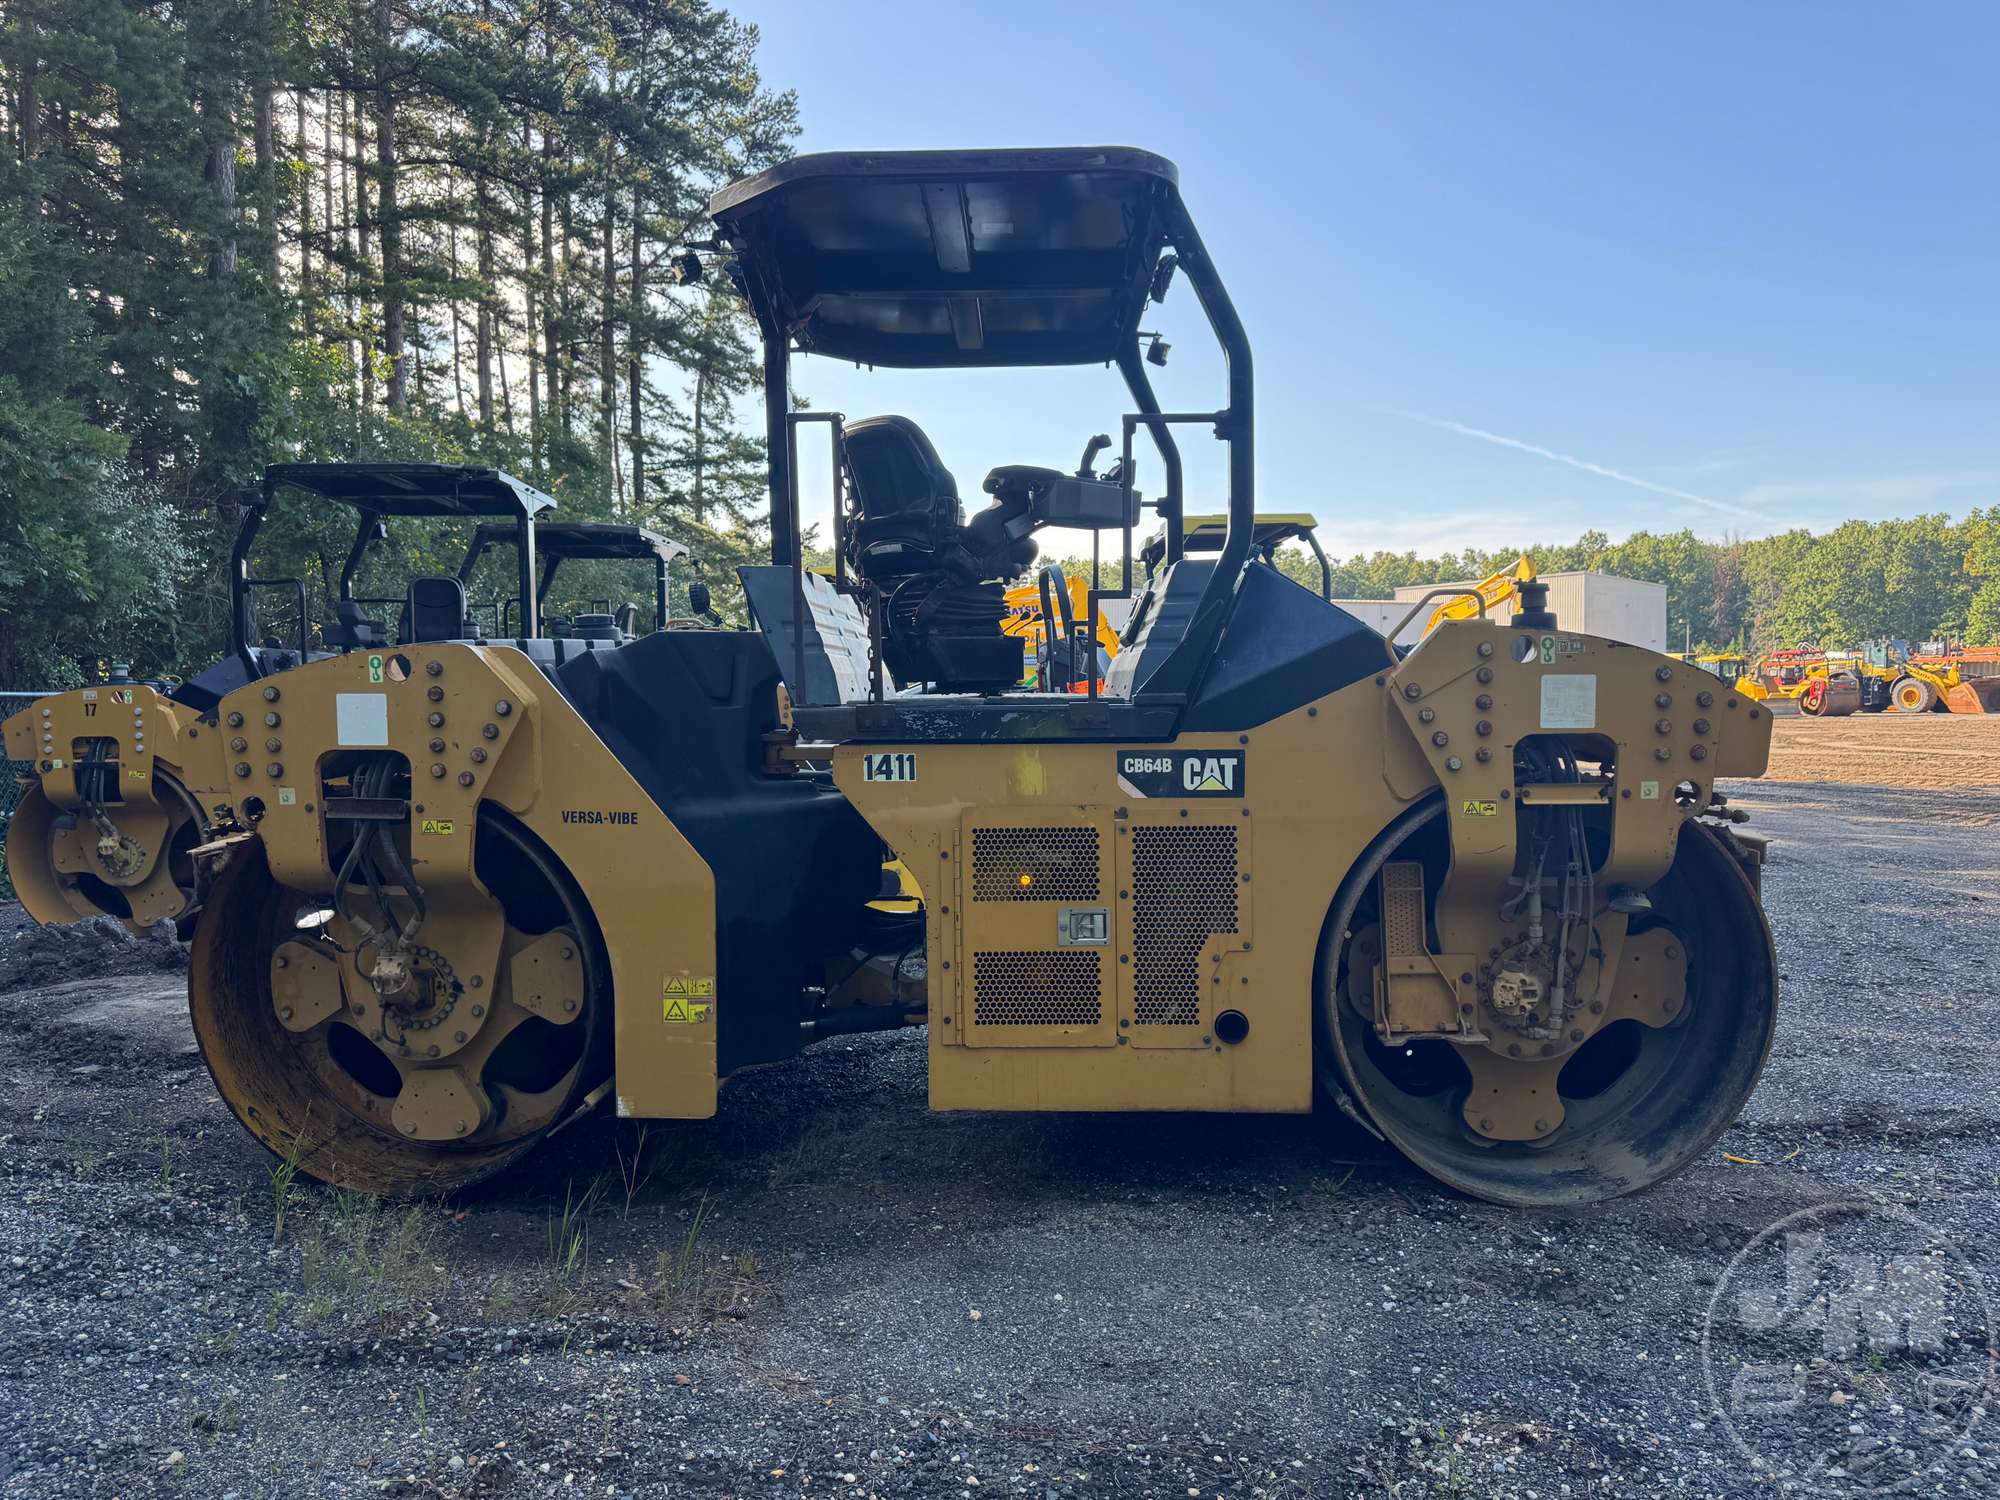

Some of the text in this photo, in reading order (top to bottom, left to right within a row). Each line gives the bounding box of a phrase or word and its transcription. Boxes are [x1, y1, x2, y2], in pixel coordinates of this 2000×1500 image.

[84, 703, 96, 716] 17
[864, 754, 915, 780] 1411
[1124, 757, 1238, 791] CB64B CAT
[561, 810, 638, 825] VERSA-VIBE
